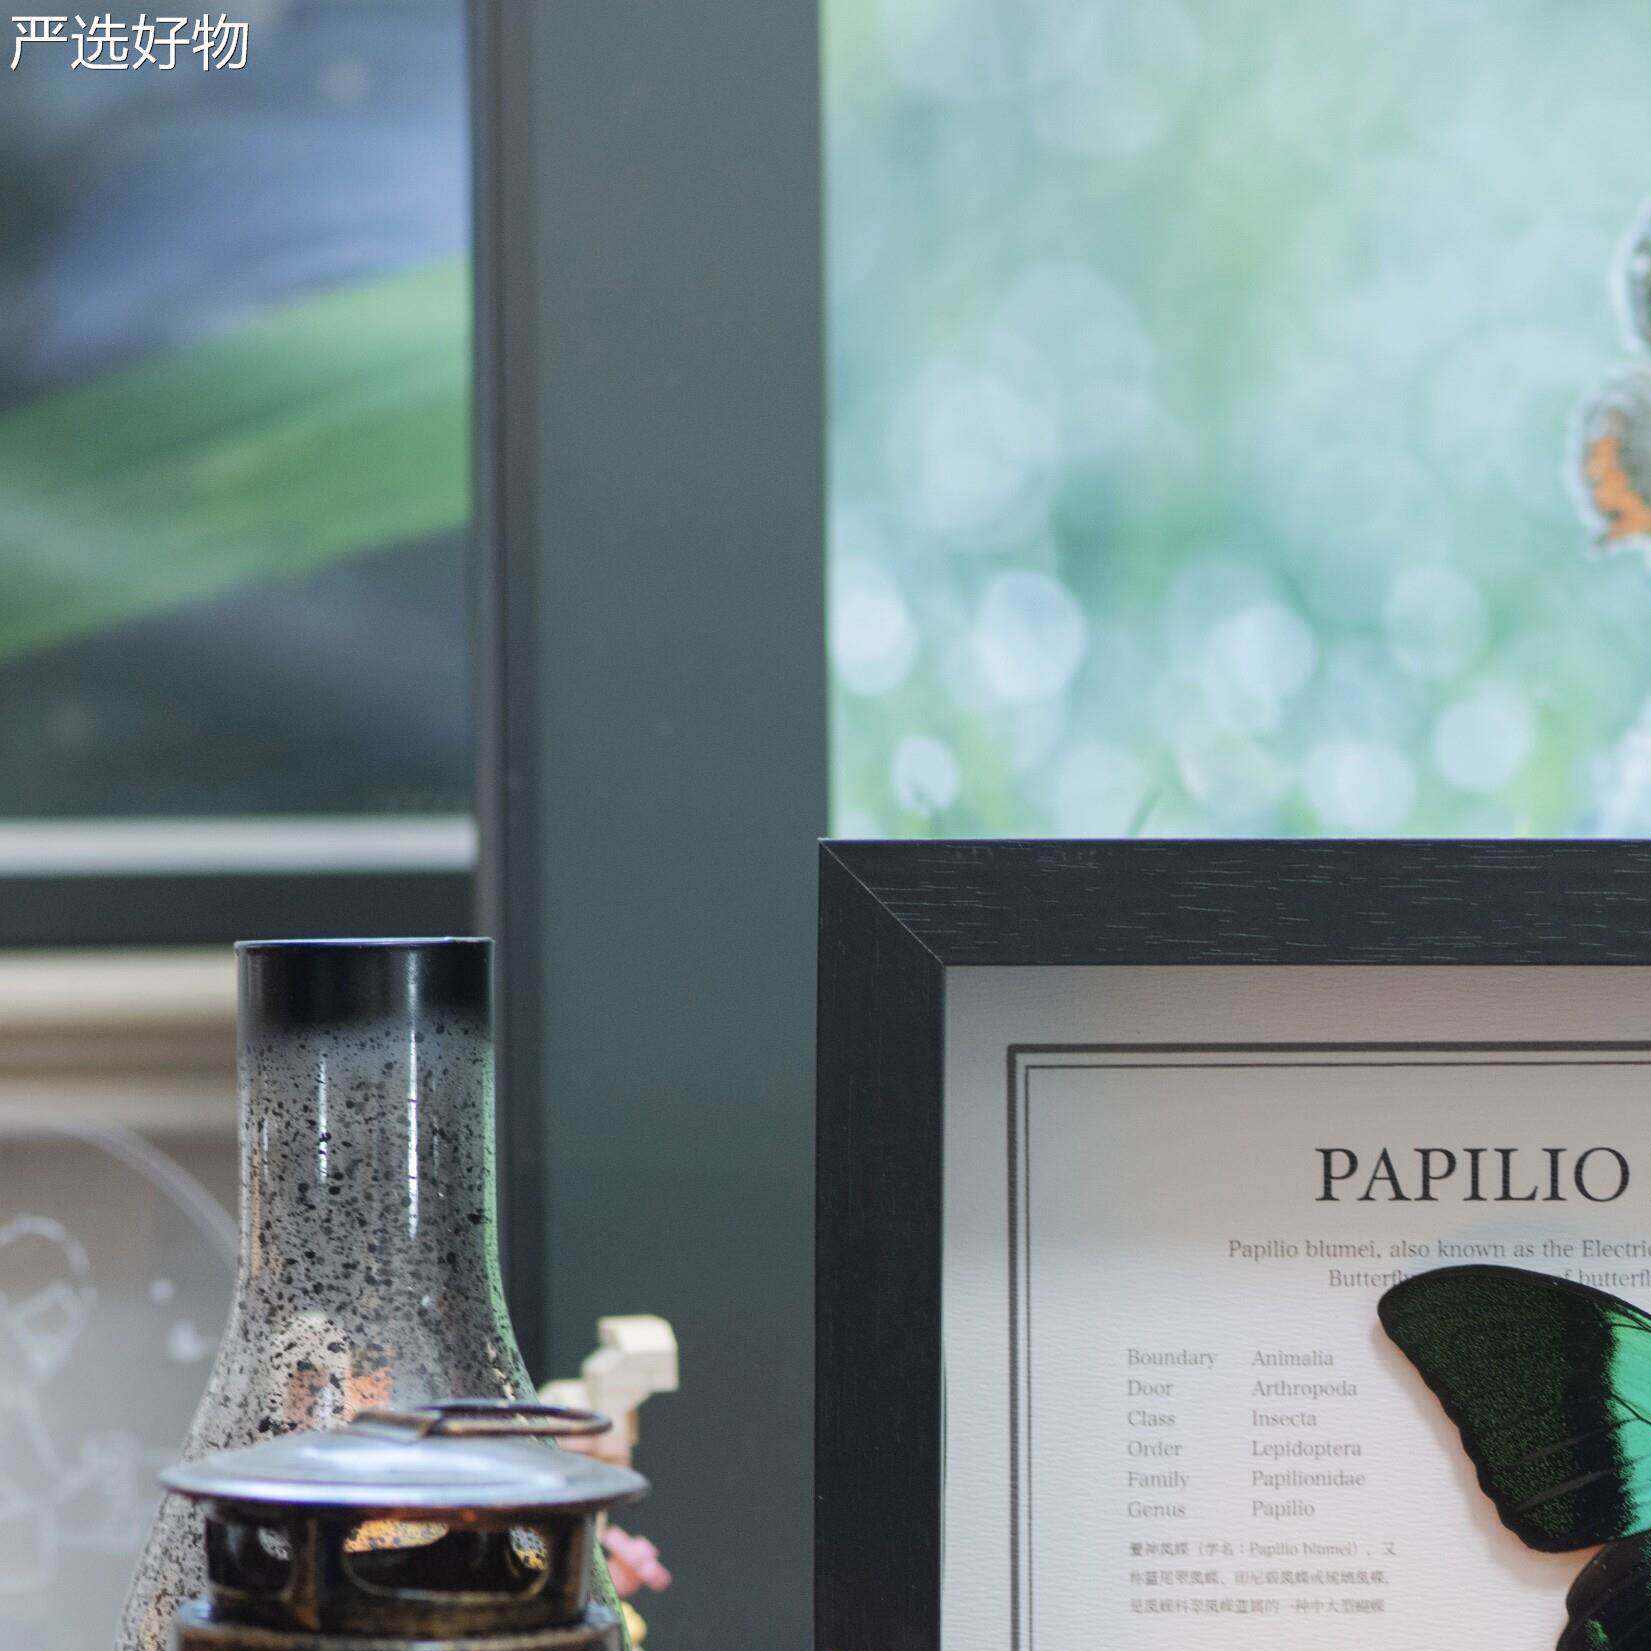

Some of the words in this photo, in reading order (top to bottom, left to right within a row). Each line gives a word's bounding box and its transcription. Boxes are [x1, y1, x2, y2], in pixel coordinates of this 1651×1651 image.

[1314, 1147, 1630, 1202] PAPILIO
[1229, 1239, 1298, 1263] Papilio
[1305, 1239, 1381, 1260] blumei,
[1390, 1239, 1430, 1258] also
[1438, 1239, 1505, 1258] known
[1513, 1245, 1534, 1258] as
[1542, 1239, 1574, 1258] the
[1127, 1349, 1217, 1370] Boundary
[1251, 1349, 1334, 1367] Animalia
[1127, 1379, 1174, 1397] Door
[1251, 1379, 1357, 1399] Arthropoda
[1127, 1410, 1176, 1427] Class
[1251, 1410, 1317, 1427] Insecta
[1127, 1440, 1183, 1457] Order
[1251, 1440, 1361, 1460] Lepidoptera
[1127, 1470, 1190, 1490] Family
[1251, 1469, 1366, 1490] Papilionidae
[1127, 1501, 1186, 1518] Genus
[1251, 1500, 1316, 1519] Papilio
